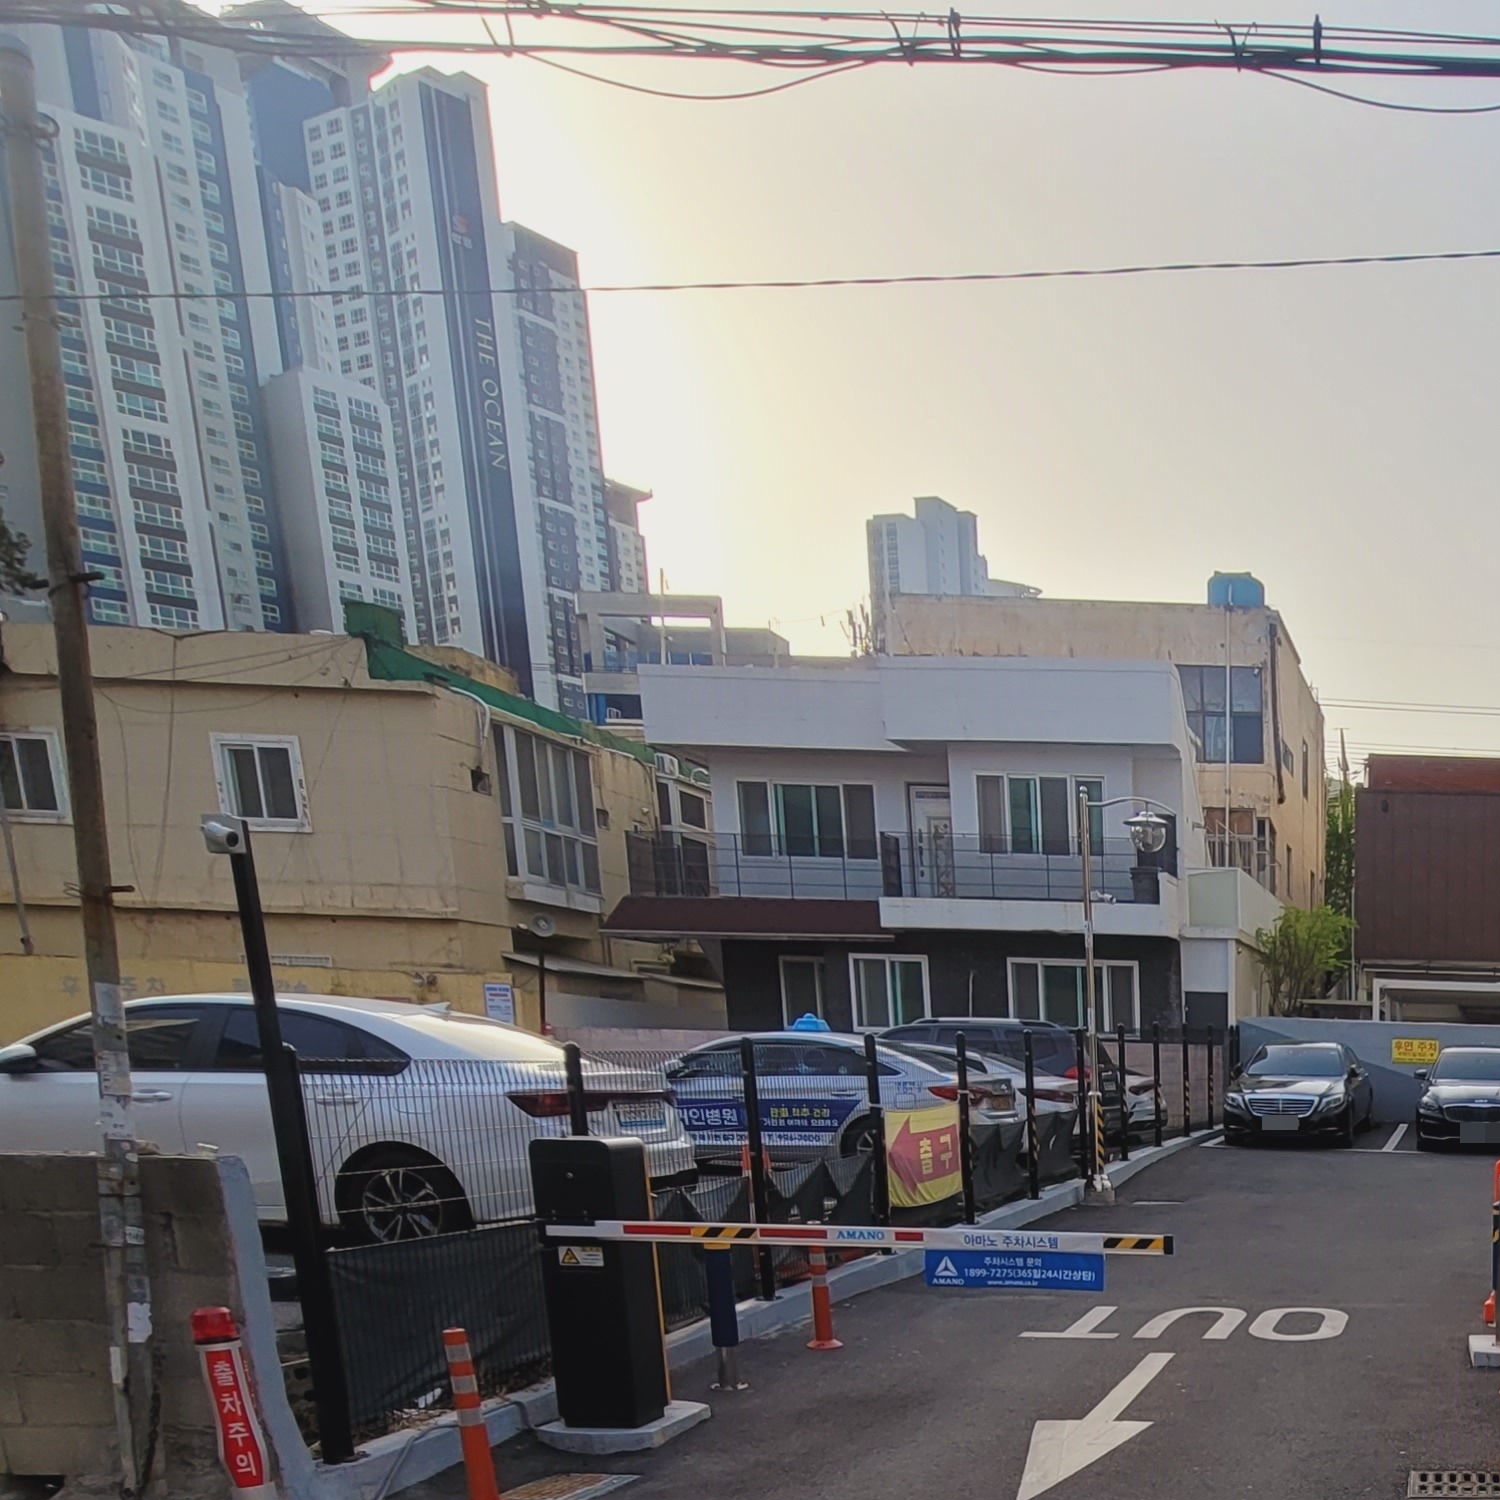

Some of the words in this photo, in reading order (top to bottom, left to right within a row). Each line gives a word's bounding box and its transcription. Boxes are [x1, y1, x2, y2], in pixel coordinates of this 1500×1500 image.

[474, 316, 496, 368] THE
[481, 377, 508, 471] OCEAN
[1417, 1041, 1437, 1053] 주차
[917, 1132, 953, 1175] 출구
[836, 1230, 885, 1241] AMANO
[963, 1234, 998, 1248] 아마노
[1001, 1234, 1059, 1250] 주차시스템
[983, 1256, 1026, 1268] 주차시스템
[1026, 1256, 1042, 1268] 문의
[932, 1278, 964, 1286] AMANO
[1017, 1305, 1349, 1341] OUT
[212, 1360, 257, 1477] 출차주의
